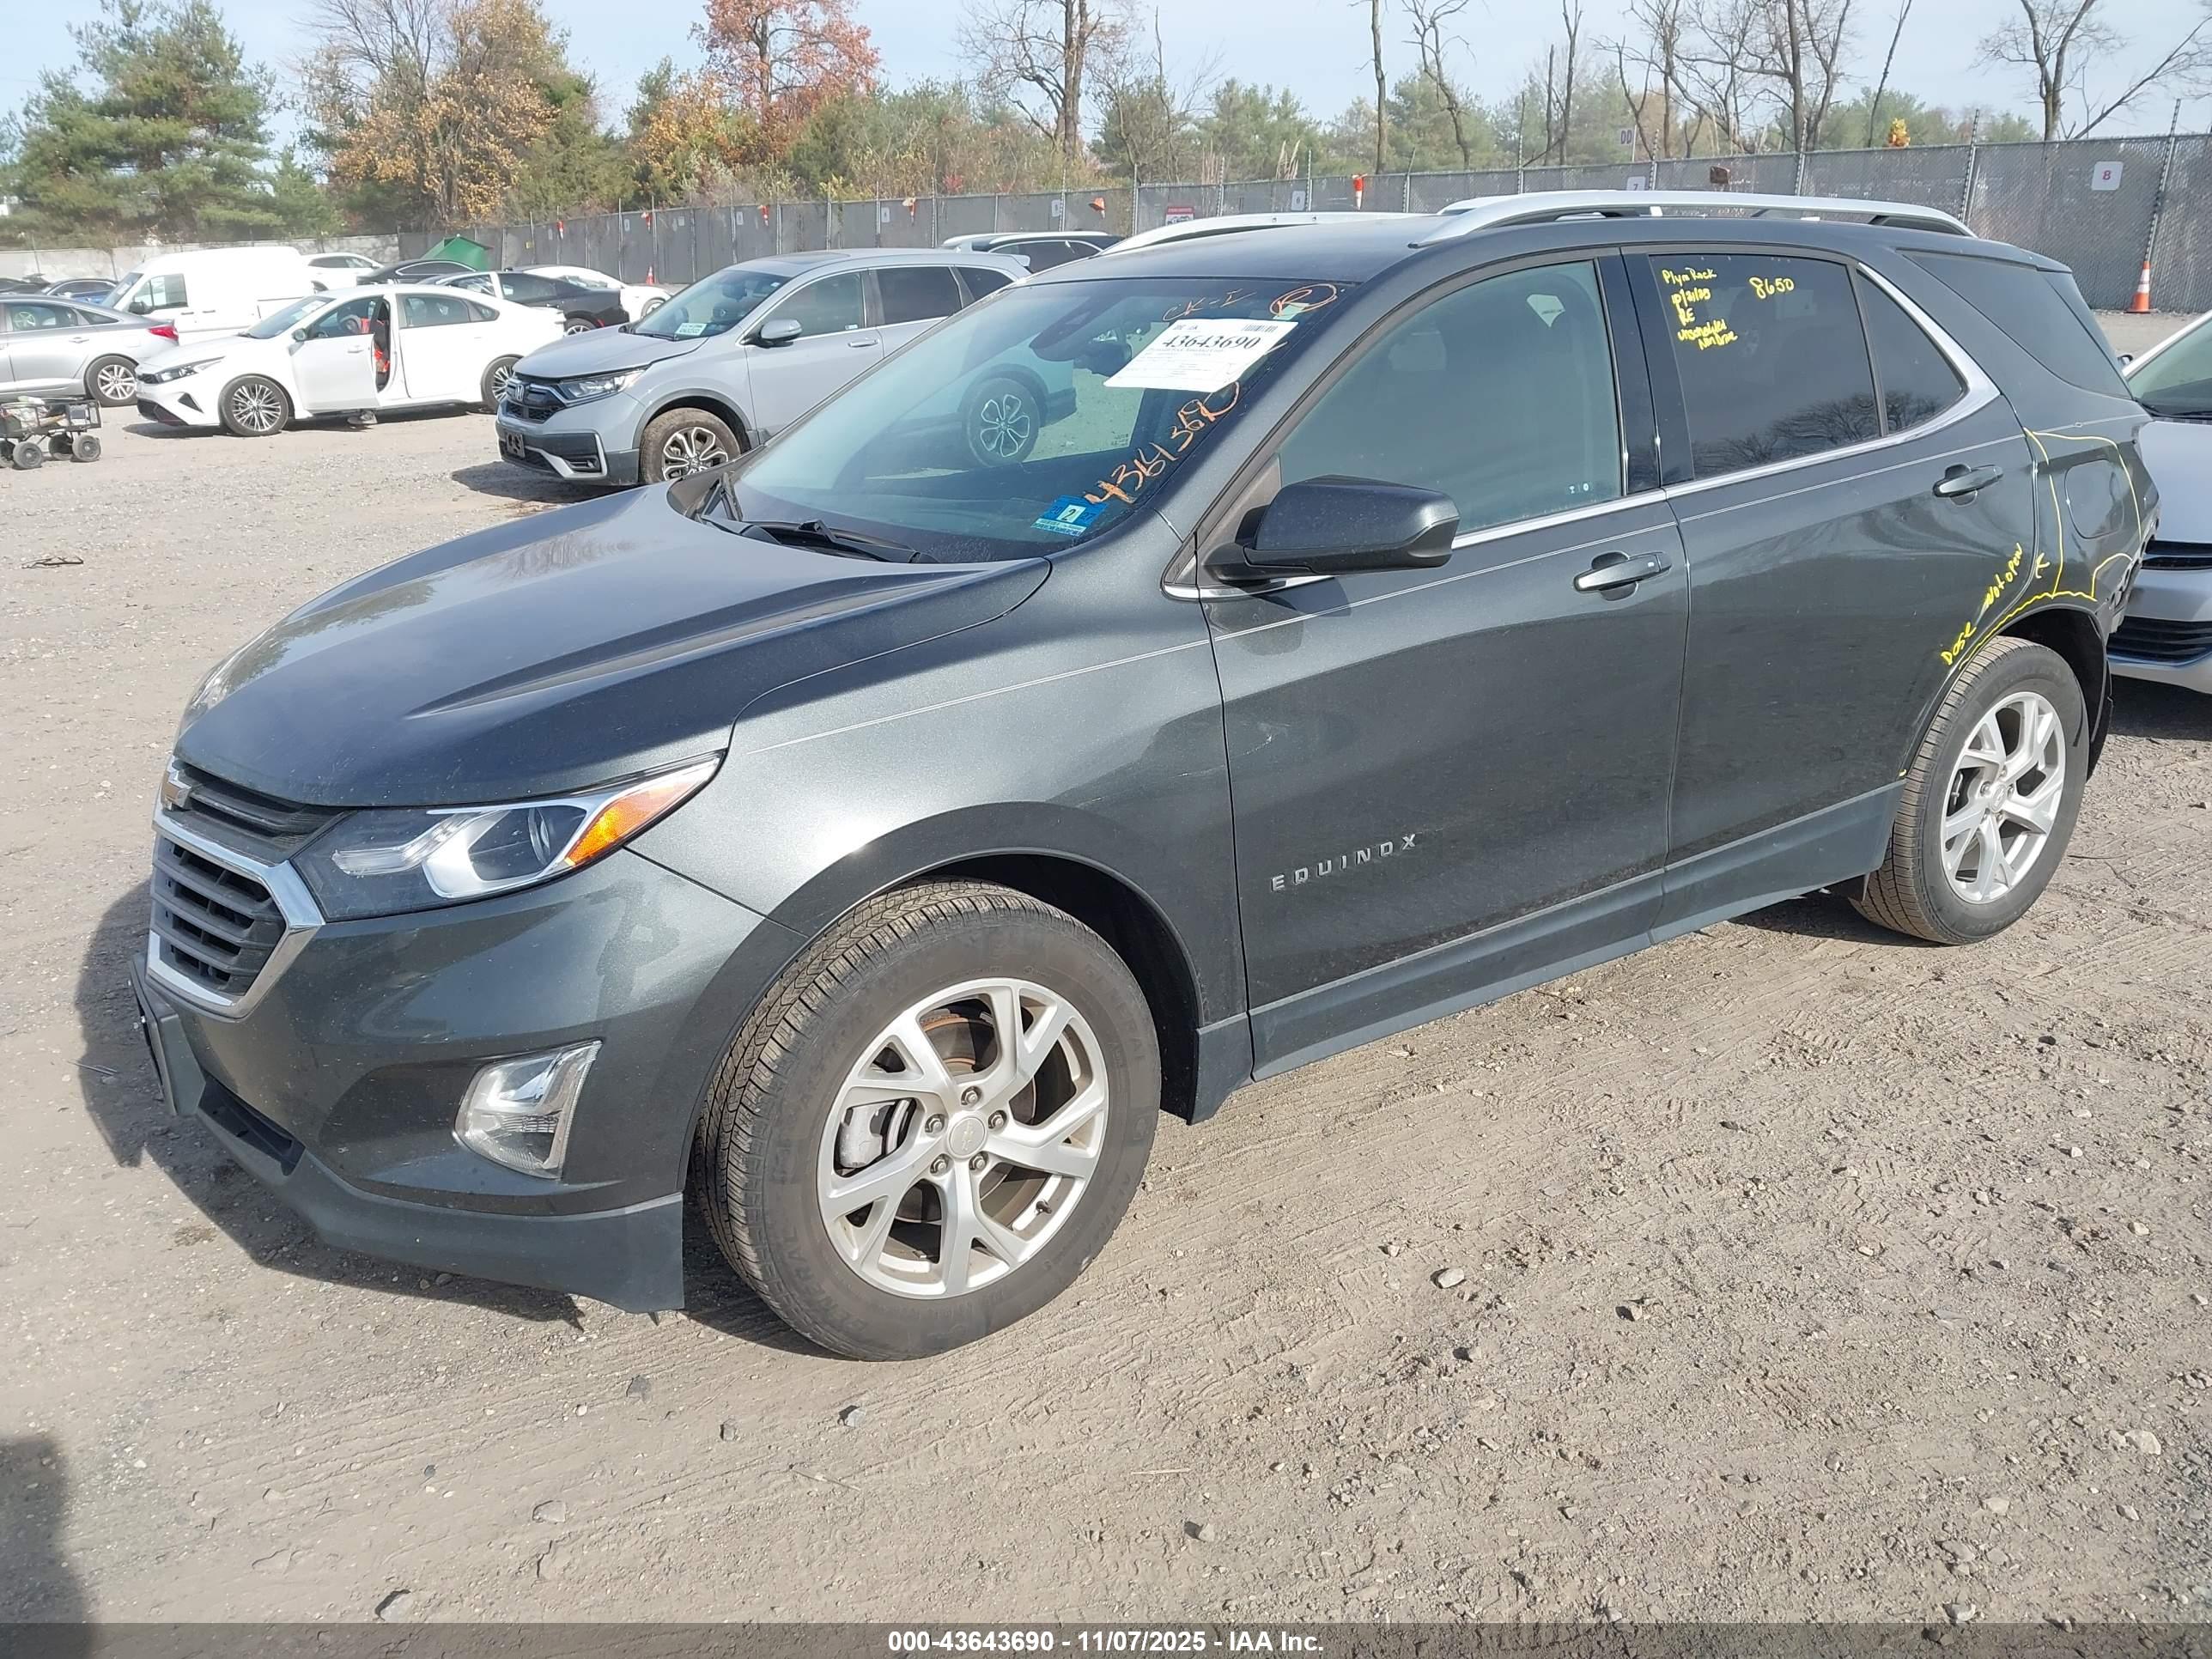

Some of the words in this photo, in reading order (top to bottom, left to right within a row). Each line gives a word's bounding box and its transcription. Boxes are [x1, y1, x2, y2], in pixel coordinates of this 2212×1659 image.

[2102, 170, 2112, 180] 8
[1748, 276, 1795, 299] 8650
[1162, 335, 1261, 349] 43643690
[1061, 508, 1077, 521] 2
[1271, 833, 1417, 892] EQUINOX
